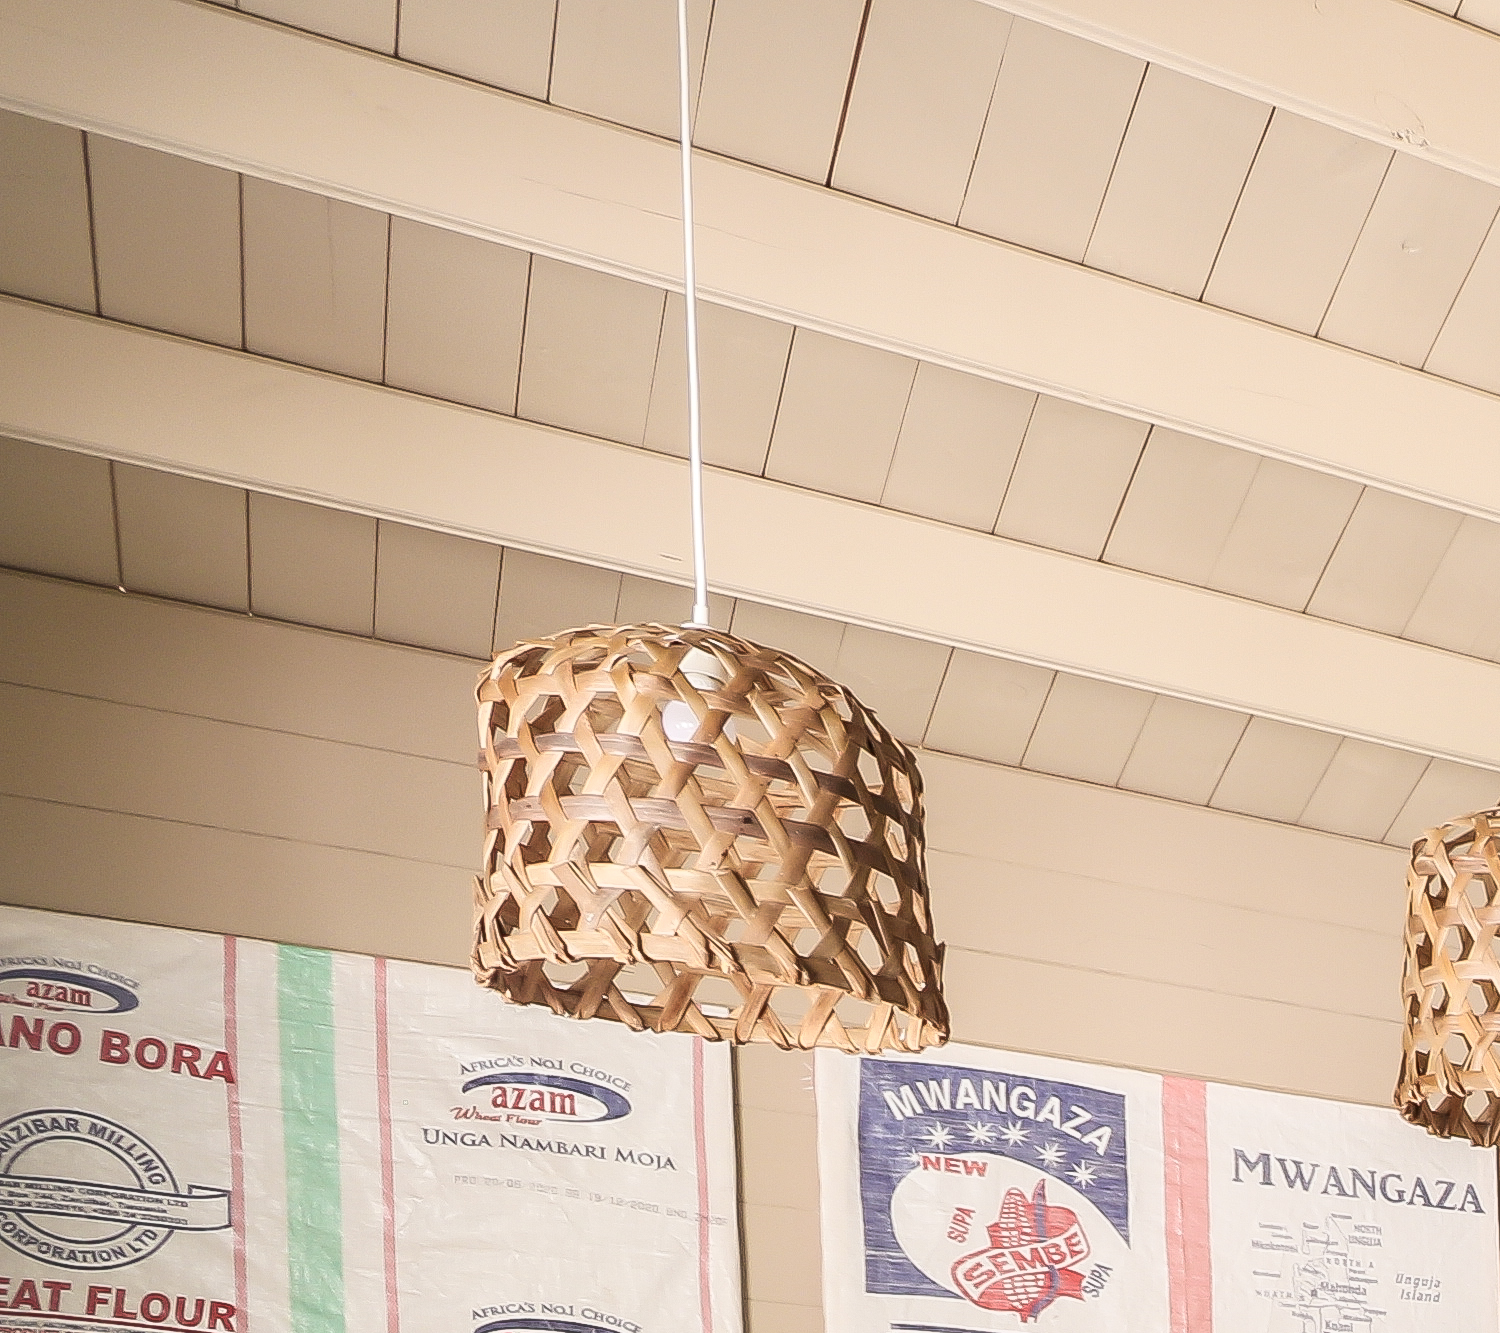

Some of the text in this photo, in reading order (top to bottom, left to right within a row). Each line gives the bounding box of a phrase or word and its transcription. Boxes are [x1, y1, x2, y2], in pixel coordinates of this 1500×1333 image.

[26, 981, 92, 1007] azam
[0, 1015, 236, 1084] NO BORA
[460, 1056, 524, 1075] AFRICA'S
[570, 1062, 632, 1093] CHOICE
[491, 1086, 578, 1117] azam
[882, 1077, 1113, 1157] MWANGAZA
[0, 1117, 167, 1186] NZIBAR MILLING
[421, 1127, 677, 1172] UNGA NAMBARI MOJA
[921, 1155, 989, 1178] NEW
[1231, 1147, 1487, 1214] MWANGAZA
[127, 1229, 158, 1252] LTD
[946, 1206, 977, 1244] SUPA
[962, 1231, 1086, 1290] SEMBE
[1081, 1262, 1114, 1298] SUPA
[1400, 1288, 1441, 1303] Island
[86, 1285, 238, 1332] FLOUR
[472, 1302, 535, 1320] AFRICA'S
